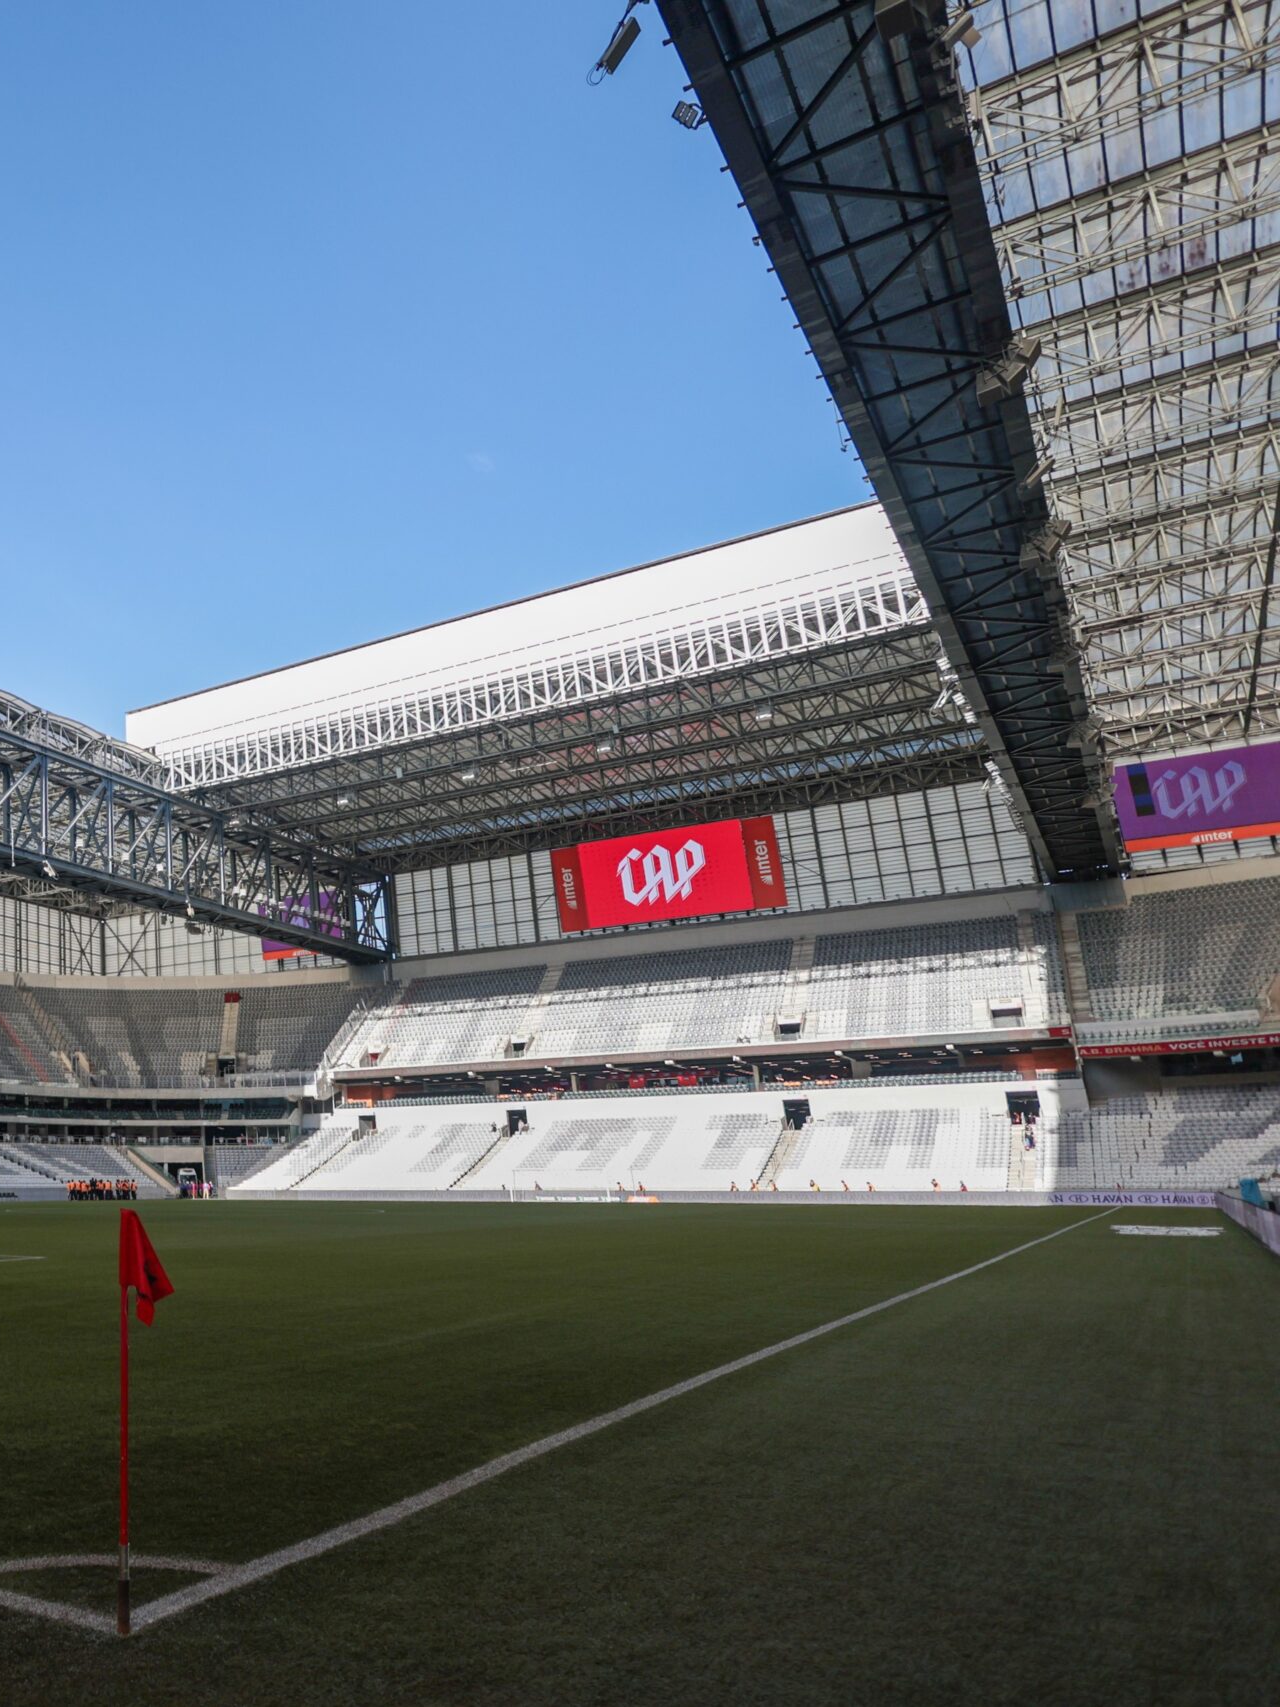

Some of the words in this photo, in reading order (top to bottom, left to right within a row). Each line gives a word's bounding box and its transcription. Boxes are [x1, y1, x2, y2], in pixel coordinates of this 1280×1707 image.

[1200, 831, 1233, 843] inter
[754, 839, 772, 874] inter
[561, 867, 576, 900] inter
[1209, 1037, 1267, 1047] INVESTE
[1092, 1195, 1133, 1204] HAVAN
[1161, 1195, 1196, 1204] HAVAN
